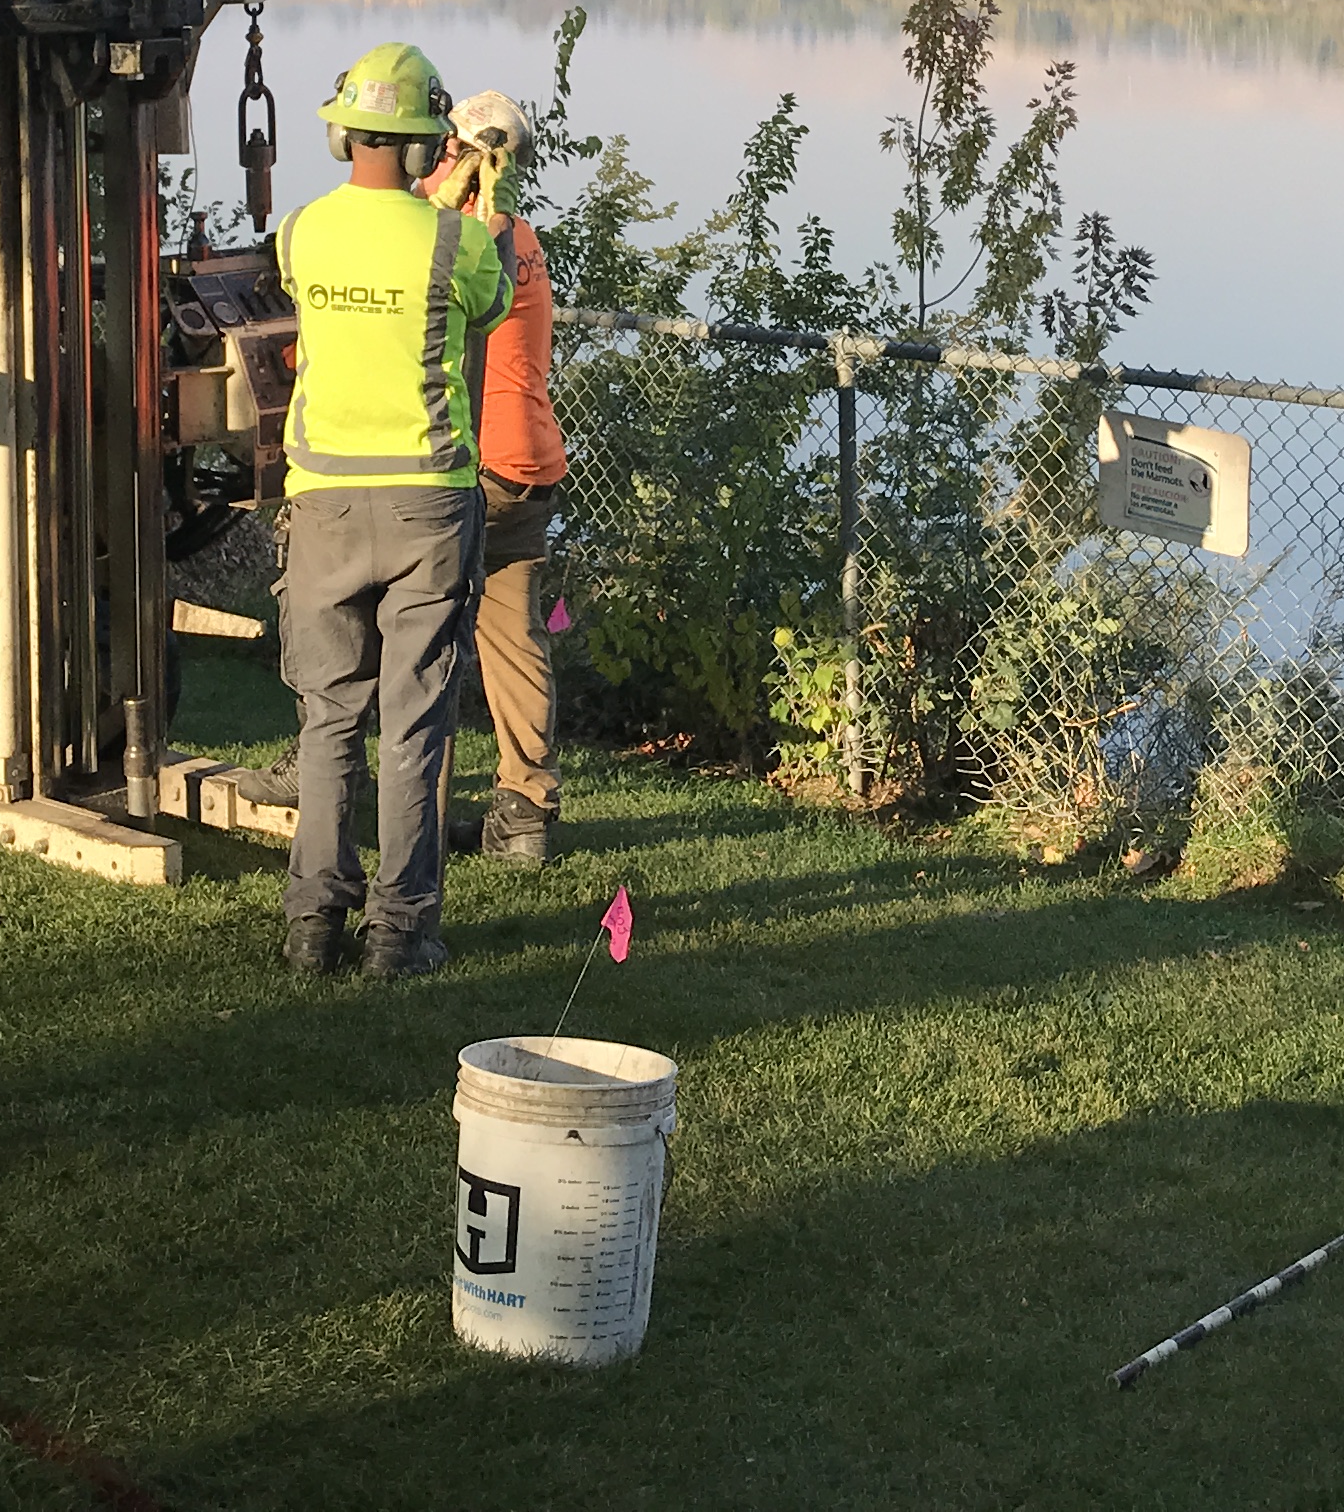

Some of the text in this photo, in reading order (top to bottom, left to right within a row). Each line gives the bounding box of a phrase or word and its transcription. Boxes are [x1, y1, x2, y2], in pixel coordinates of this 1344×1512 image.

[331, 285, 404, 306] HOLT
[331, 304, 404, 315] SERVICES INC
[1131, 457, 1173, 475] Don't feed
[1131, 468, 1145, 479] the
[486, 1289, 526, 1309] HART
